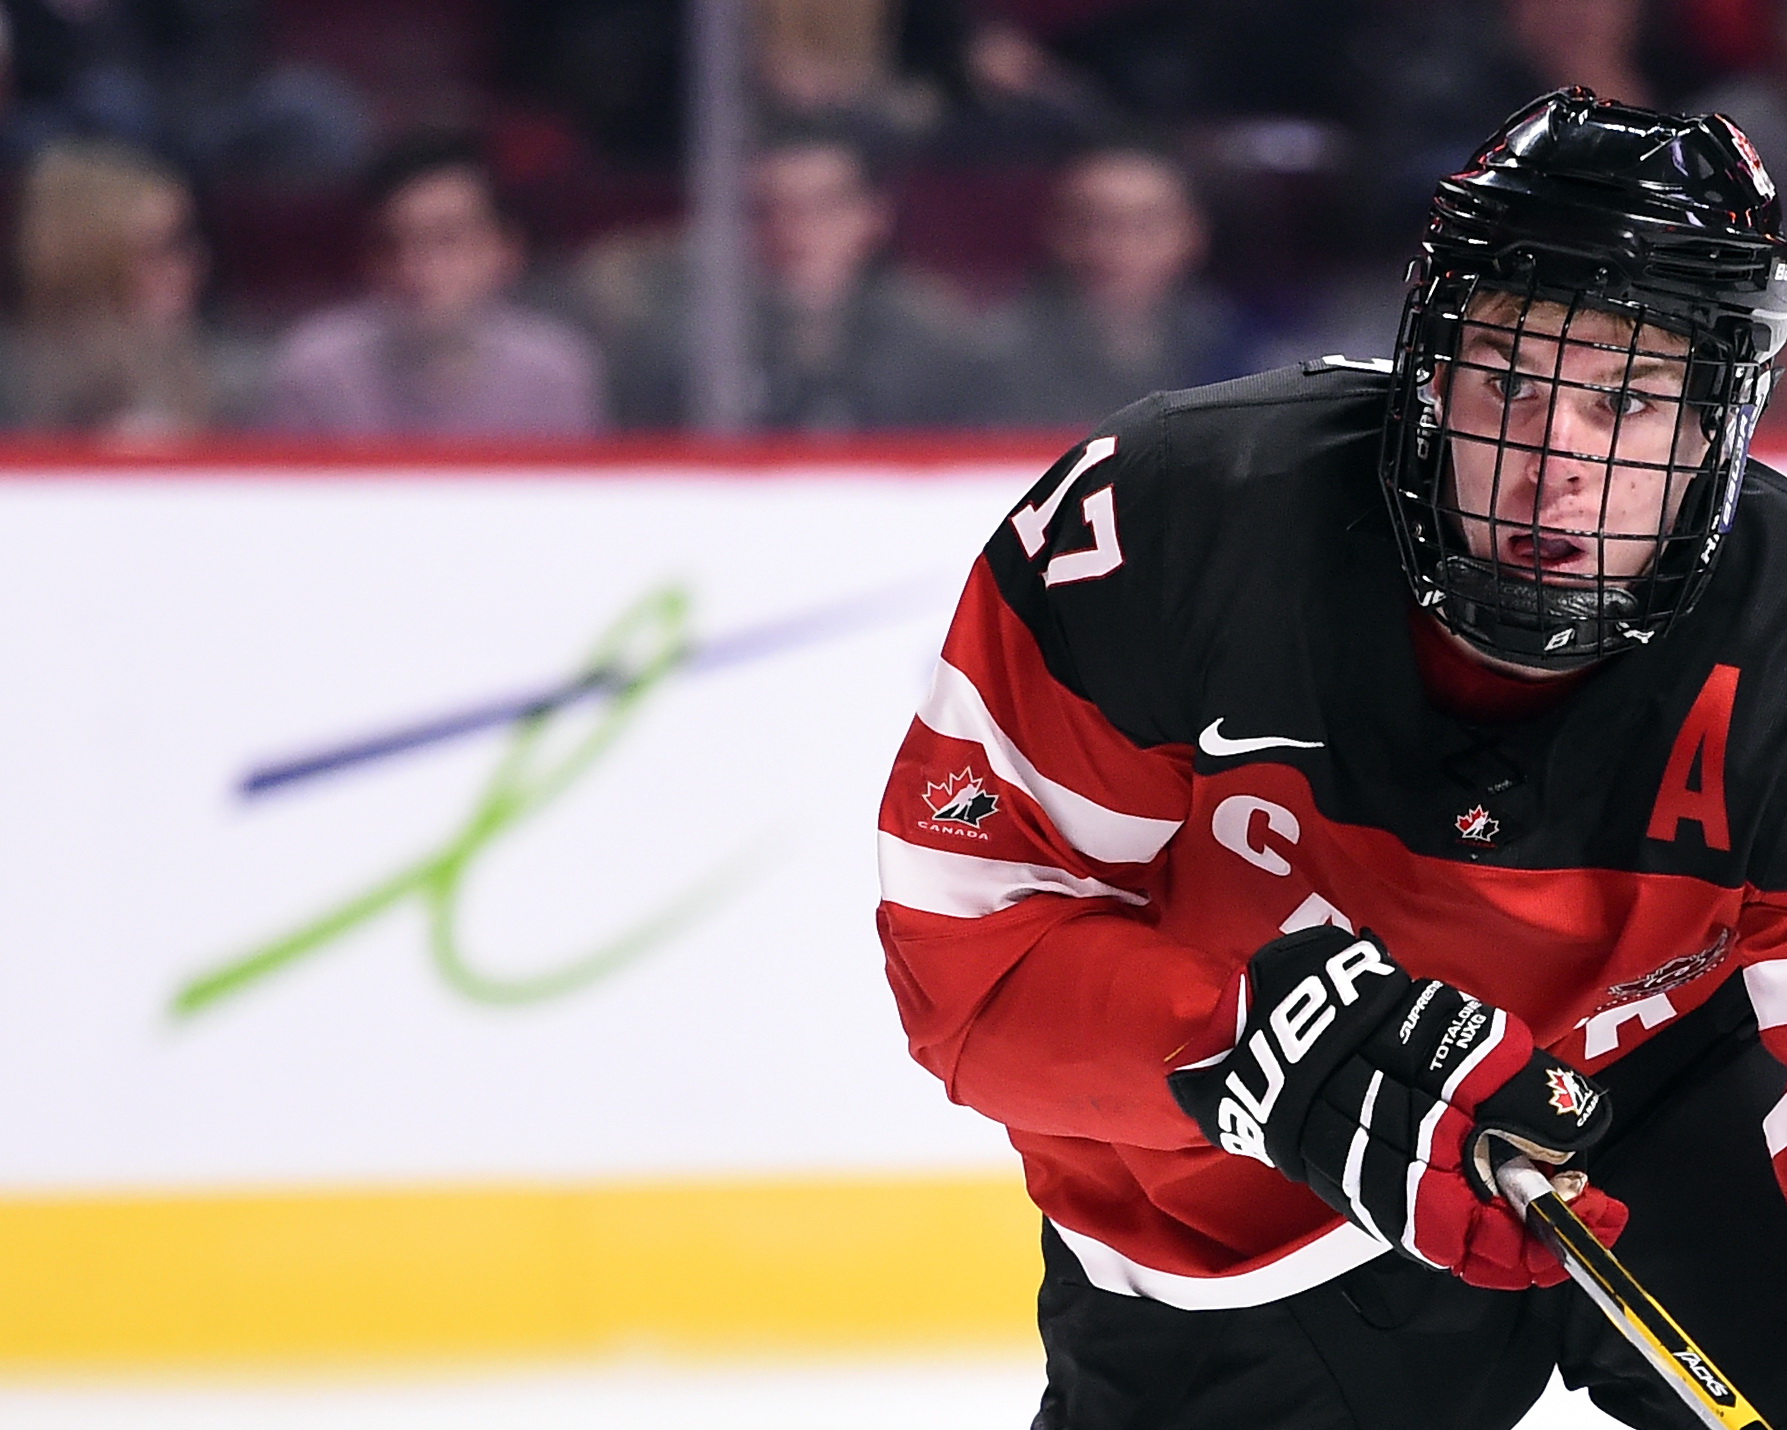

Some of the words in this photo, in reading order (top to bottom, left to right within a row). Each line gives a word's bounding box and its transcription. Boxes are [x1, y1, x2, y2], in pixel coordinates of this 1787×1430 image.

[1010, 434, 1125, 589] 17
[1646, 663, 1741, 851] A
[917, 821, 989, 840] CANADA
[1455, 1013, 1487, 1049] NXG
